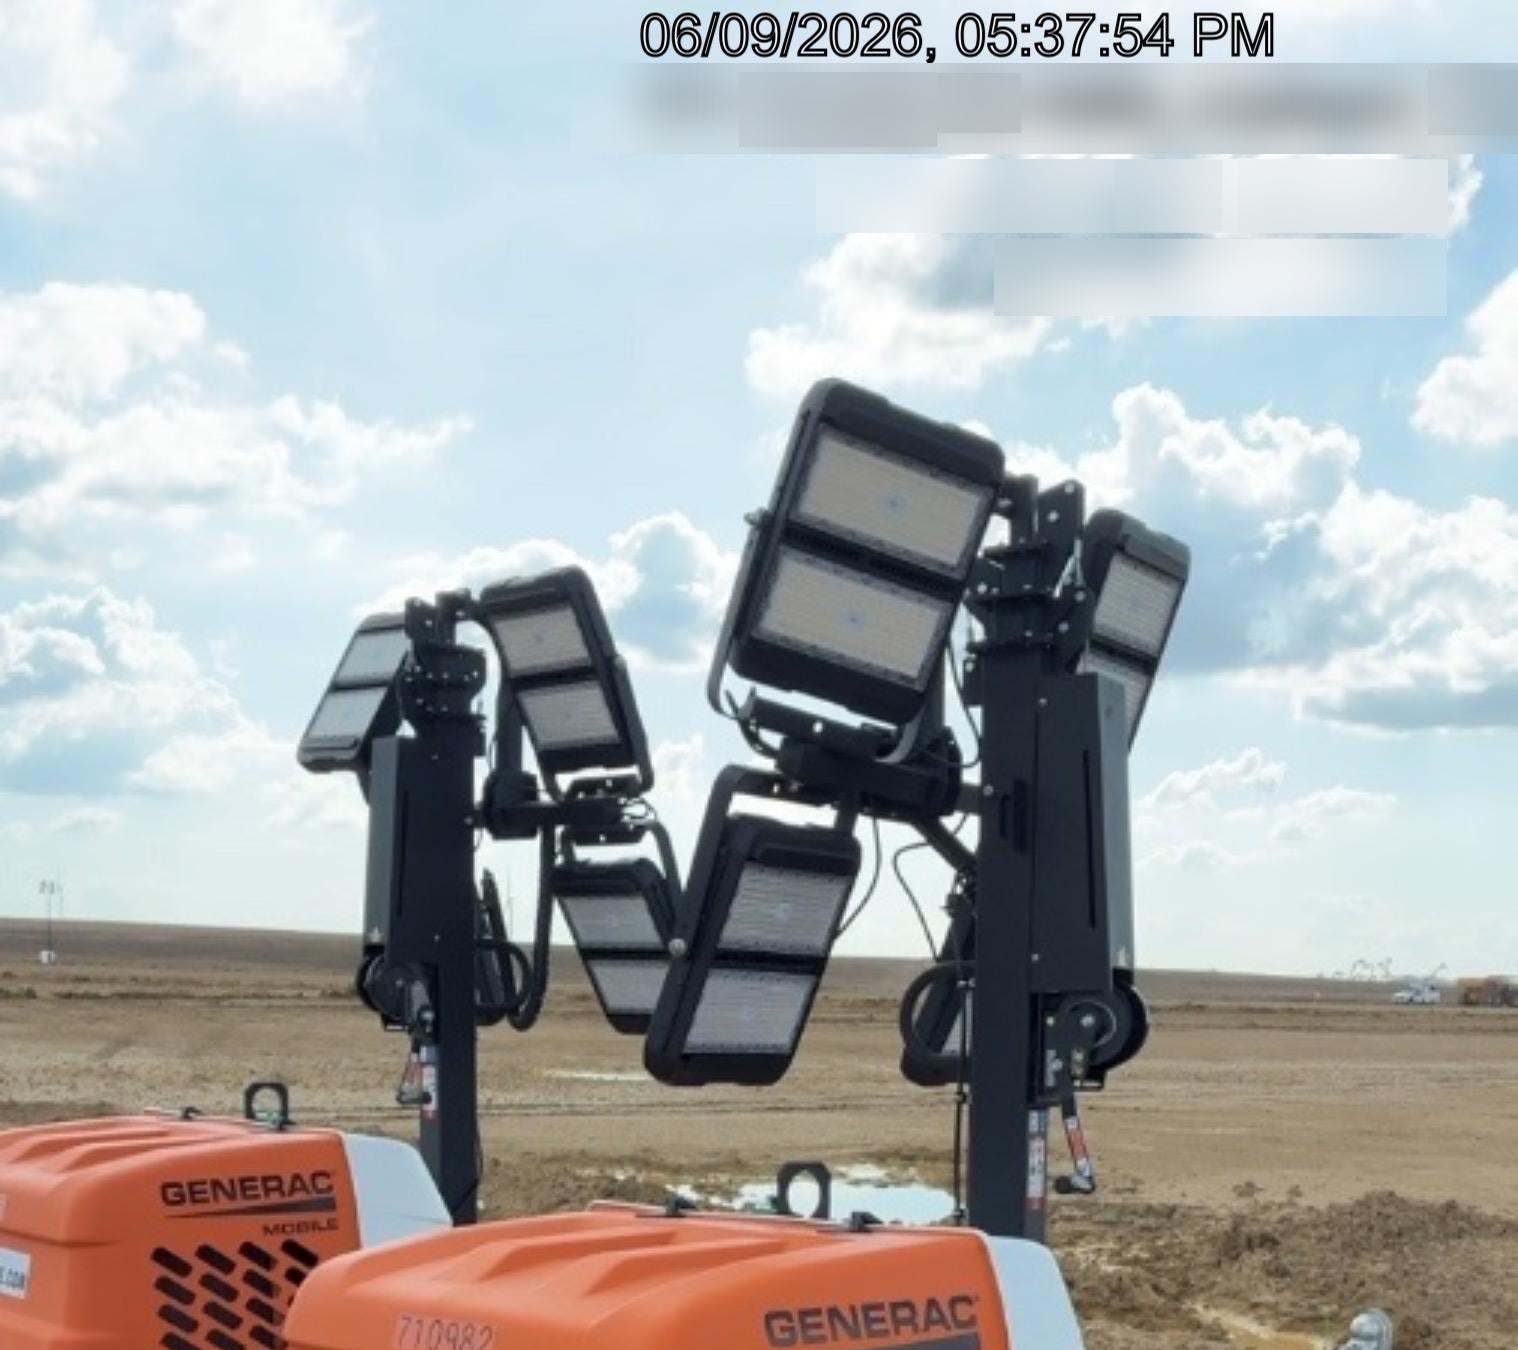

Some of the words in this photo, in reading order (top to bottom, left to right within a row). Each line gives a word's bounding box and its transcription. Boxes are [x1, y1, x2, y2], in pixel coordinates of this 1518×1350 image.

[160, 1170, 334, 1206] GENERAC
[263, 1218, 338, 1237] MOBILE
[764, 1295, 978, 1348] GENERAC
